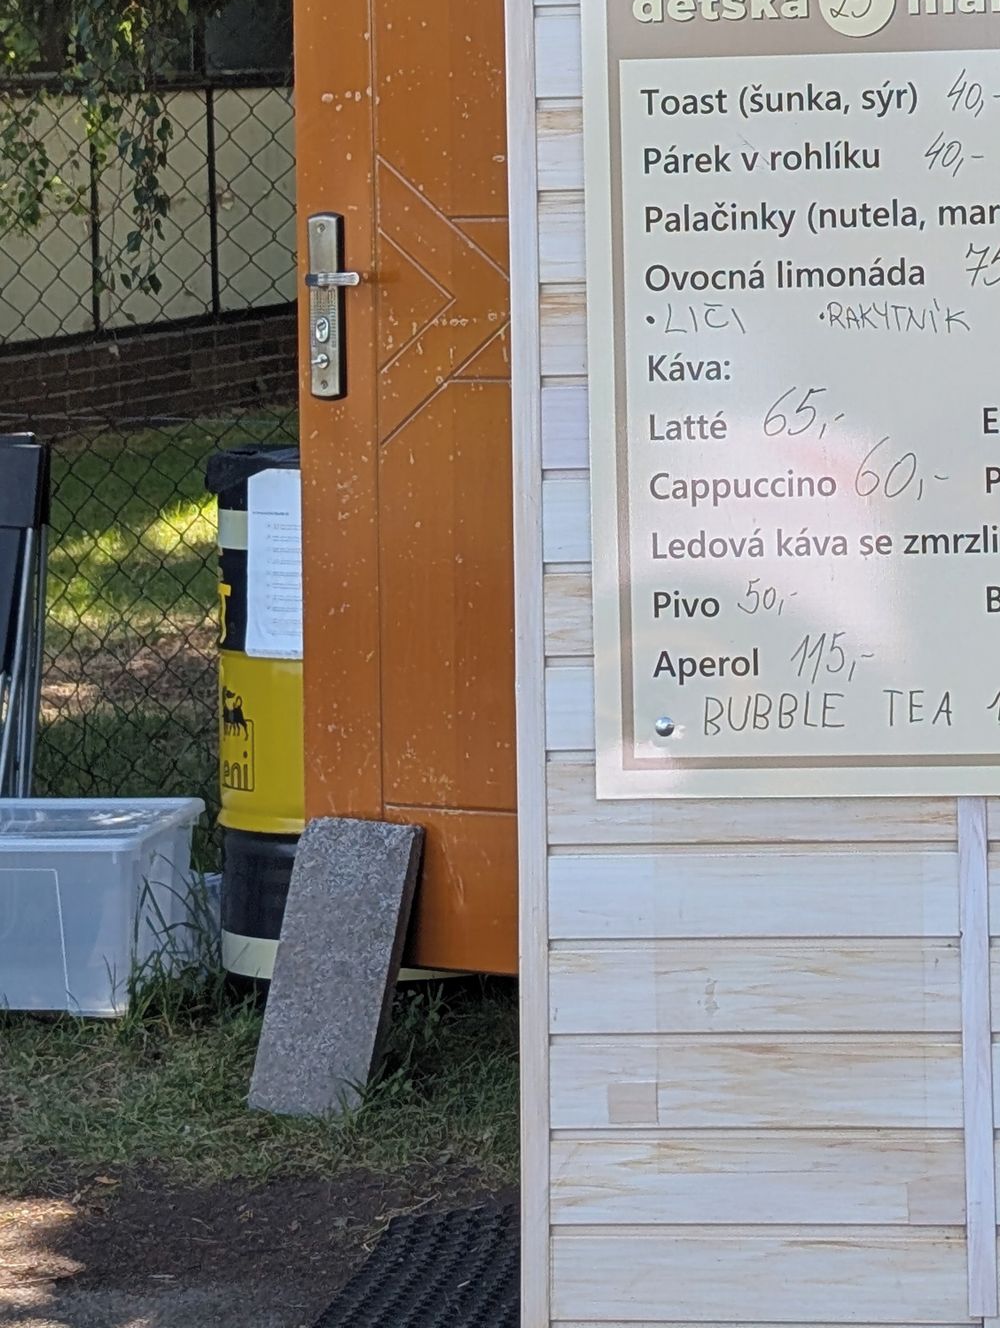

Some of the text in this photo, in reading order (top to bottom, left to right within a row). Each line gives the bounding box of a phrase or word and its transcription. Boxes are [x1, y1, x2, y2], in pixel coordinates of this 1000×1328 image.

[641, 86, 727, 116] Toast
[739, 83, 850, 118] (šunka,
[861, 79, 918, 117] sýr)
[643, 131, 985, 178] Párek v rohlíku 40,-
[645, 201, 796, 238] Palačinky
[808, 198, 926, 234] (nutela,
[644, 261, 765, 292] Ovocná
[777, 257, 925, 289] limonáda
[648, 353, 732, 382] Káva:
[649, 386, 846, 441] Latté 65,-
[649, 436, 950, 508] Cappuccino 60,-
[652, 529, 765, 560] Ledová
[776, 528, 848, 558] káva
[859, 534, 893, 556] se
[653, 577, 798, 619] Pivo 50,-
[653, 648, 759, 685] Aperol
[703, 692, 846, 737] BUBBLE
[882, 689, 953, 728] TEA
